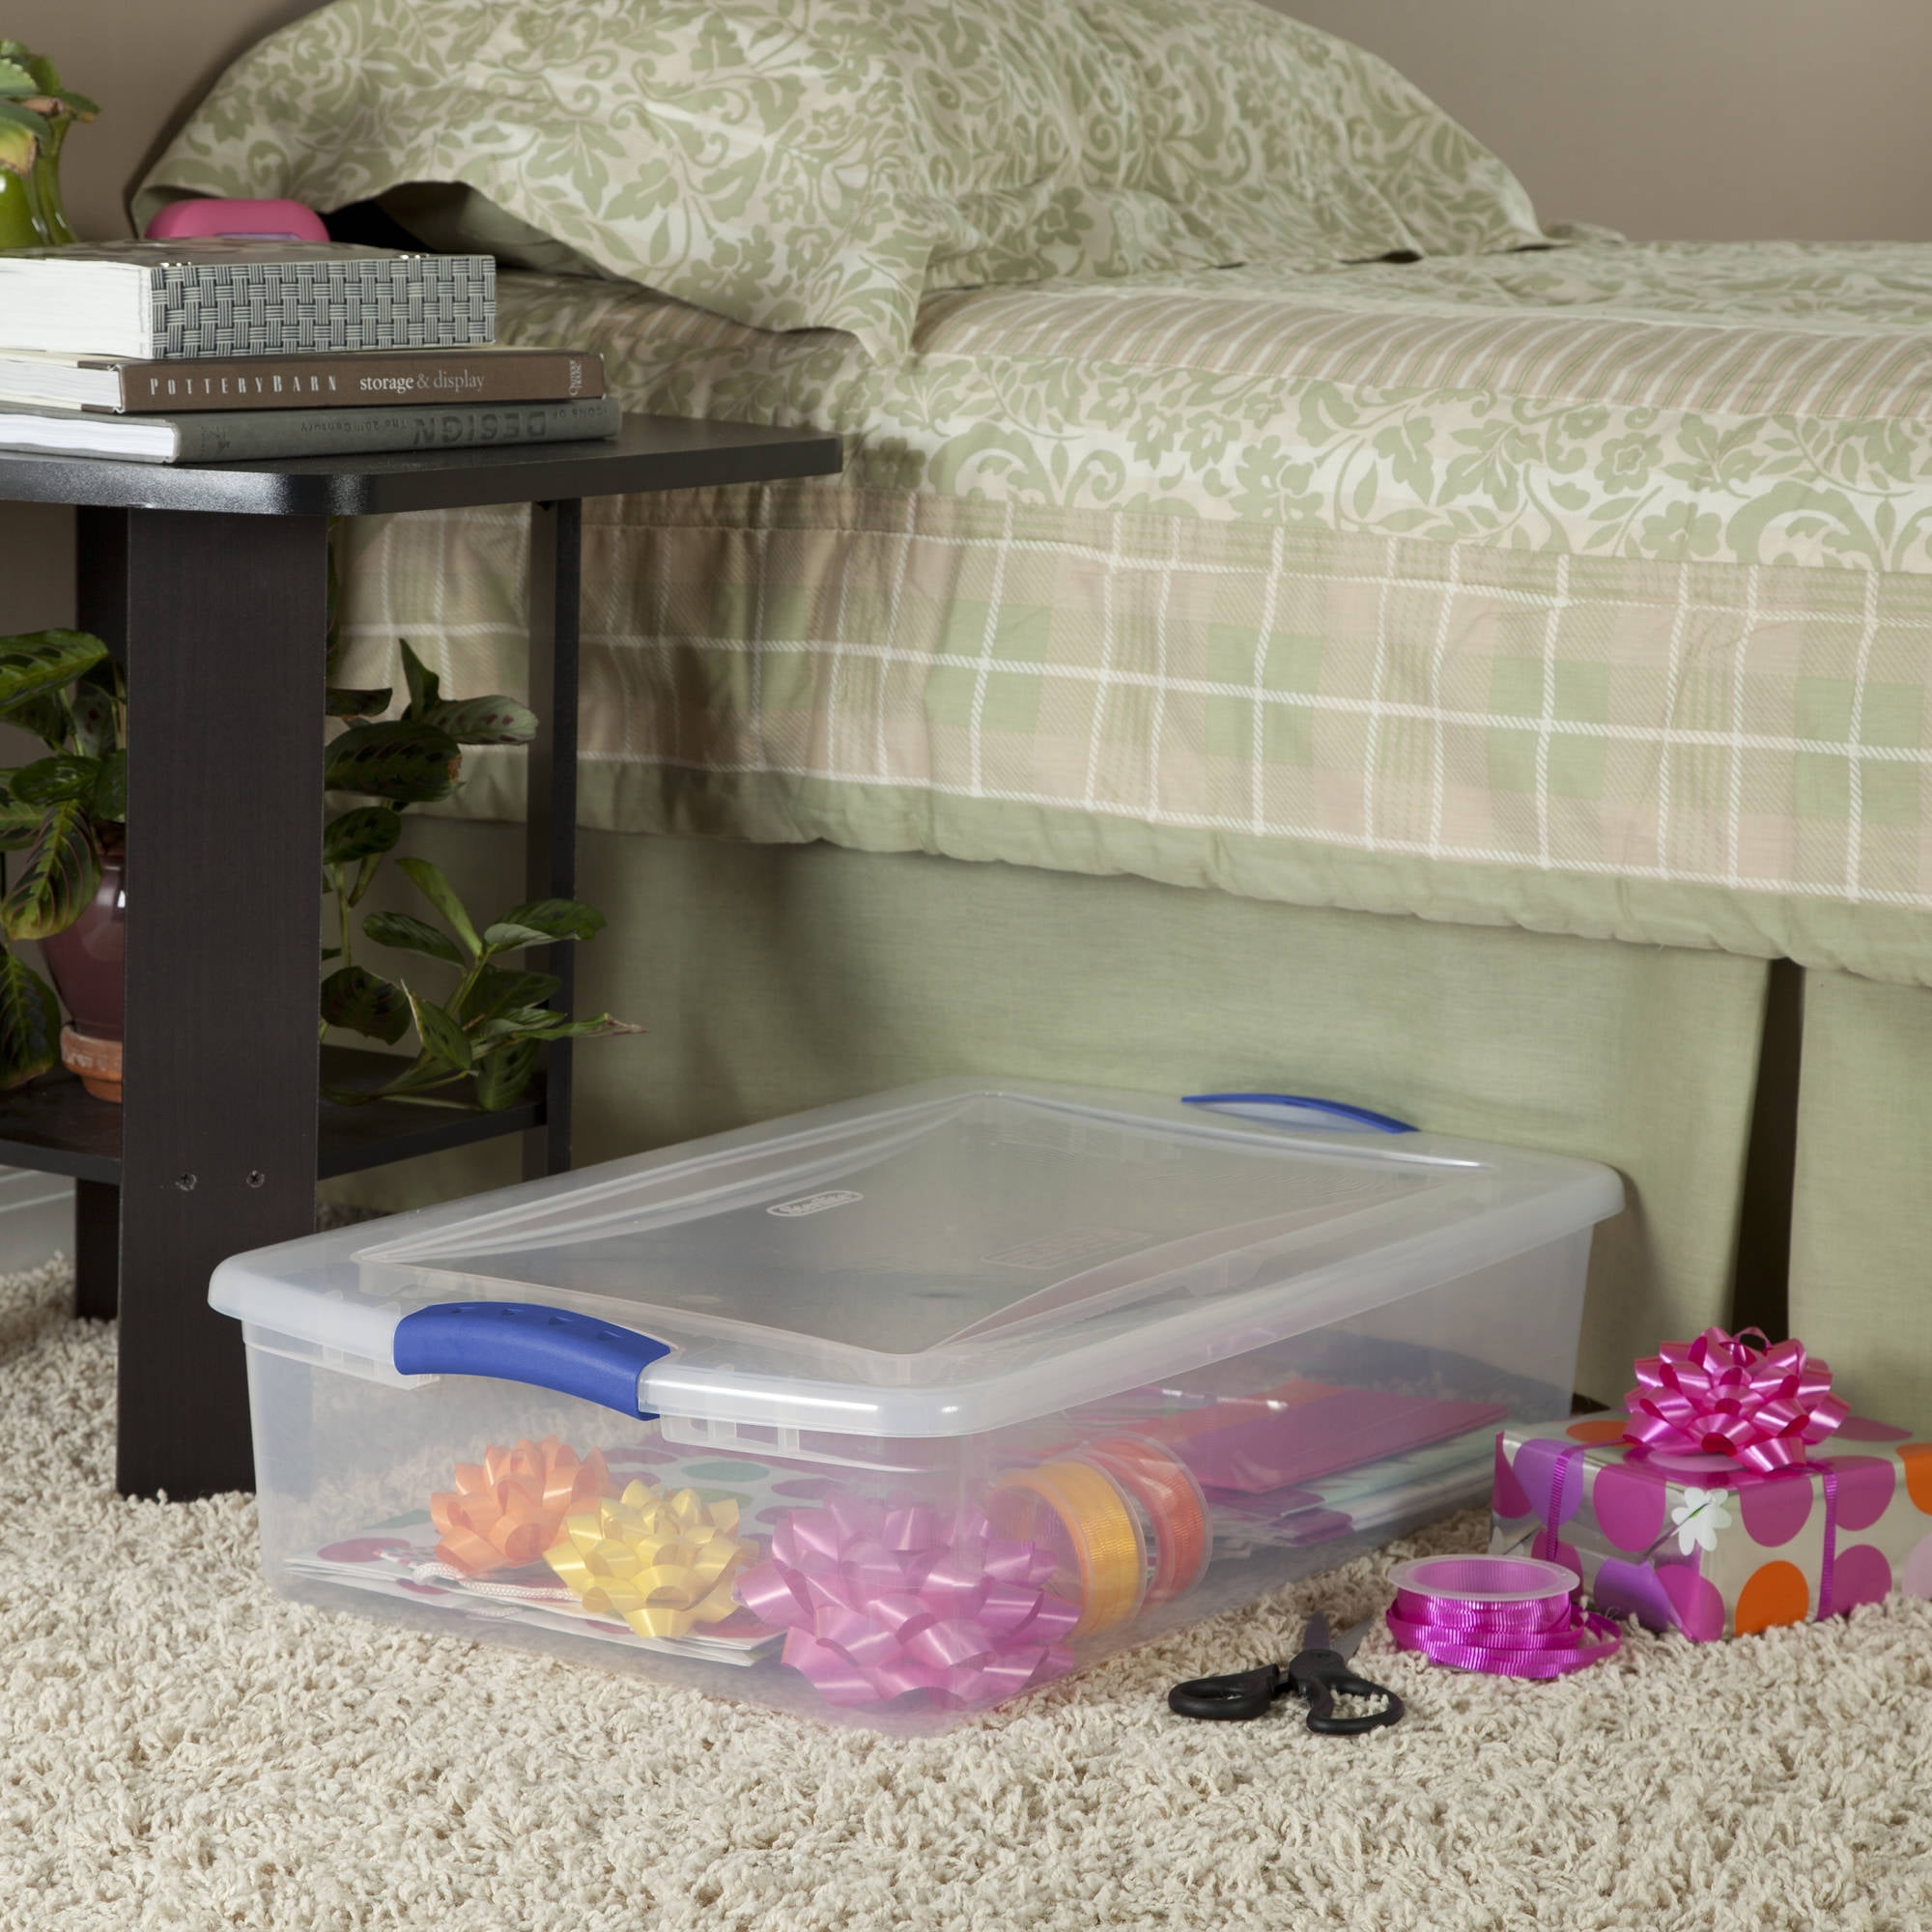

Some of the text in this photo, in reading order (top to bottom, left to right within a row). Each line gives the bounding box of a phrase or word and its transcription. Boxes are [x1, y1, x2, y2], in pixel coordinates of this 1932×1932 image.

[359, 376, 414, 394] storage
[416, 373, 431, 389] &
[433, 369, 484, 392] display
[413, 411, 547, 445] DESIGN
